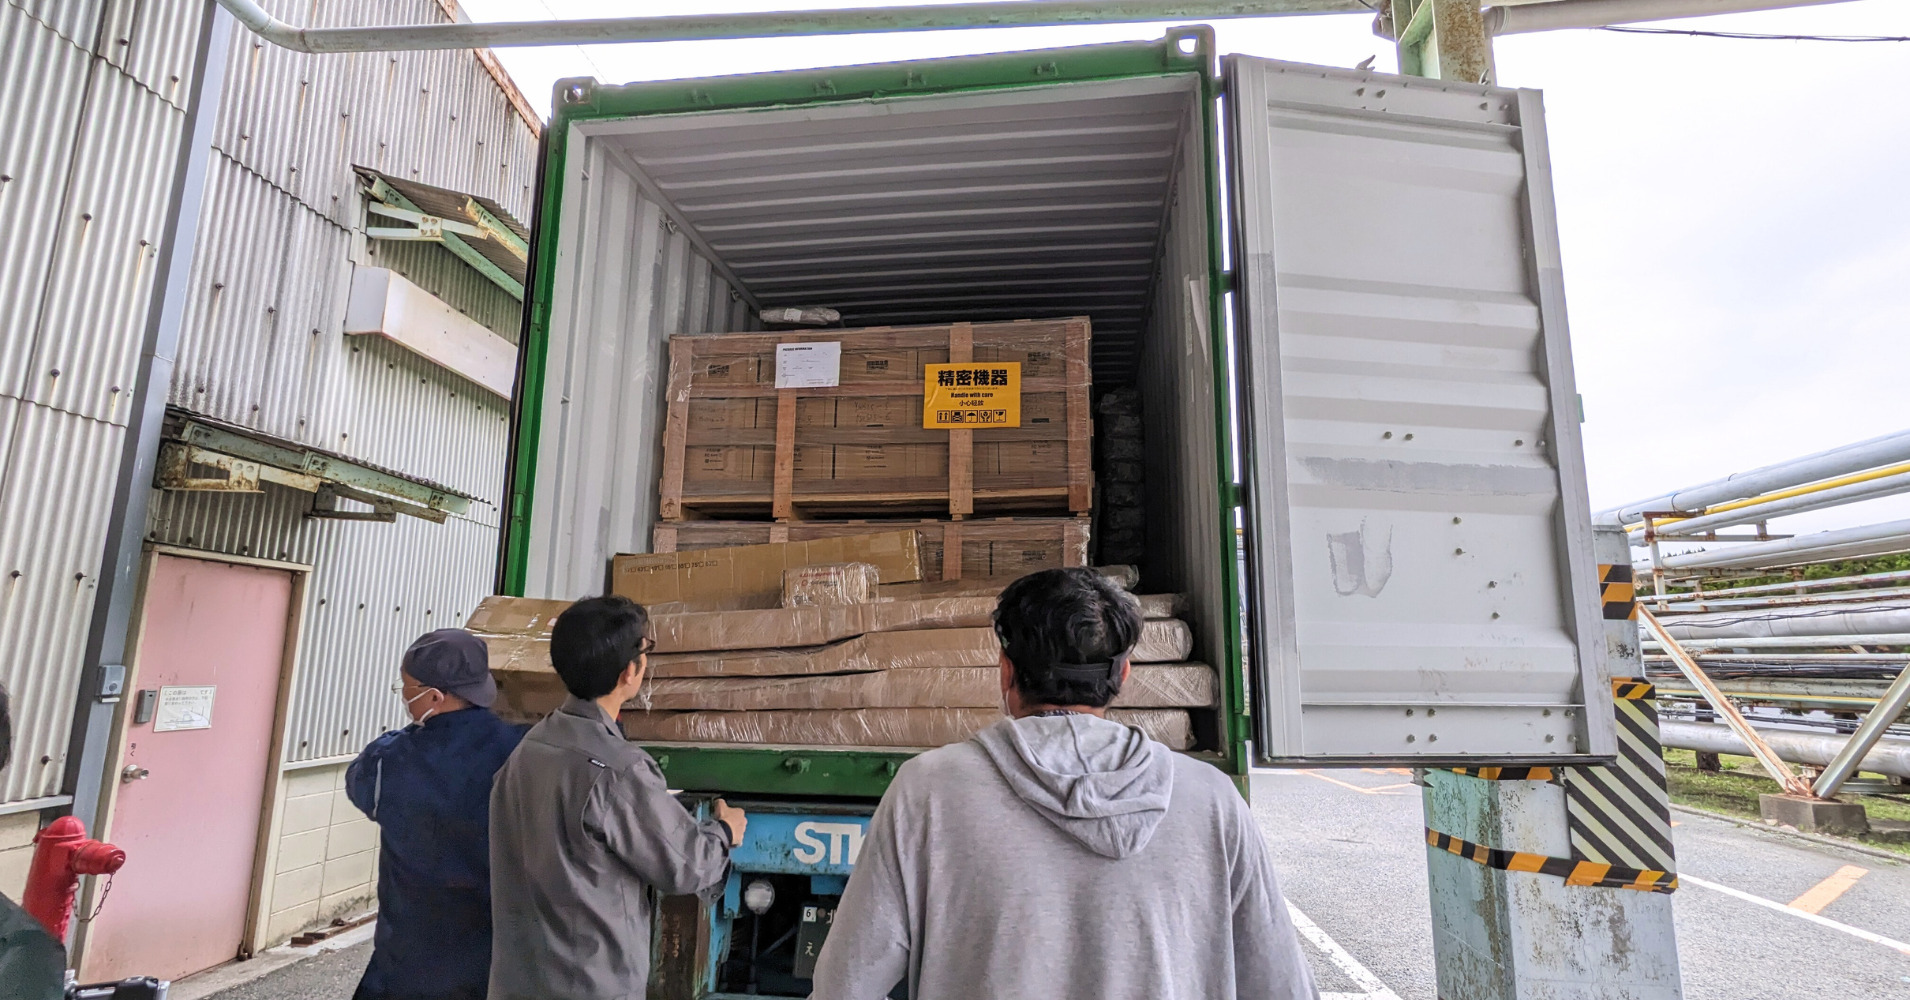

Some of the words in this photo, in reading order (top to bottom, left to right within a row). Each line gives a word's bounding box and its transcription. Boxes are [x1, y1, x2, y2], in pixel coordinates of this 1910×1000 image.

[938, 370, 1008, 386] 精密機器
[806, 909, 811, 917] 6
[805, 942, 814, 956] え
